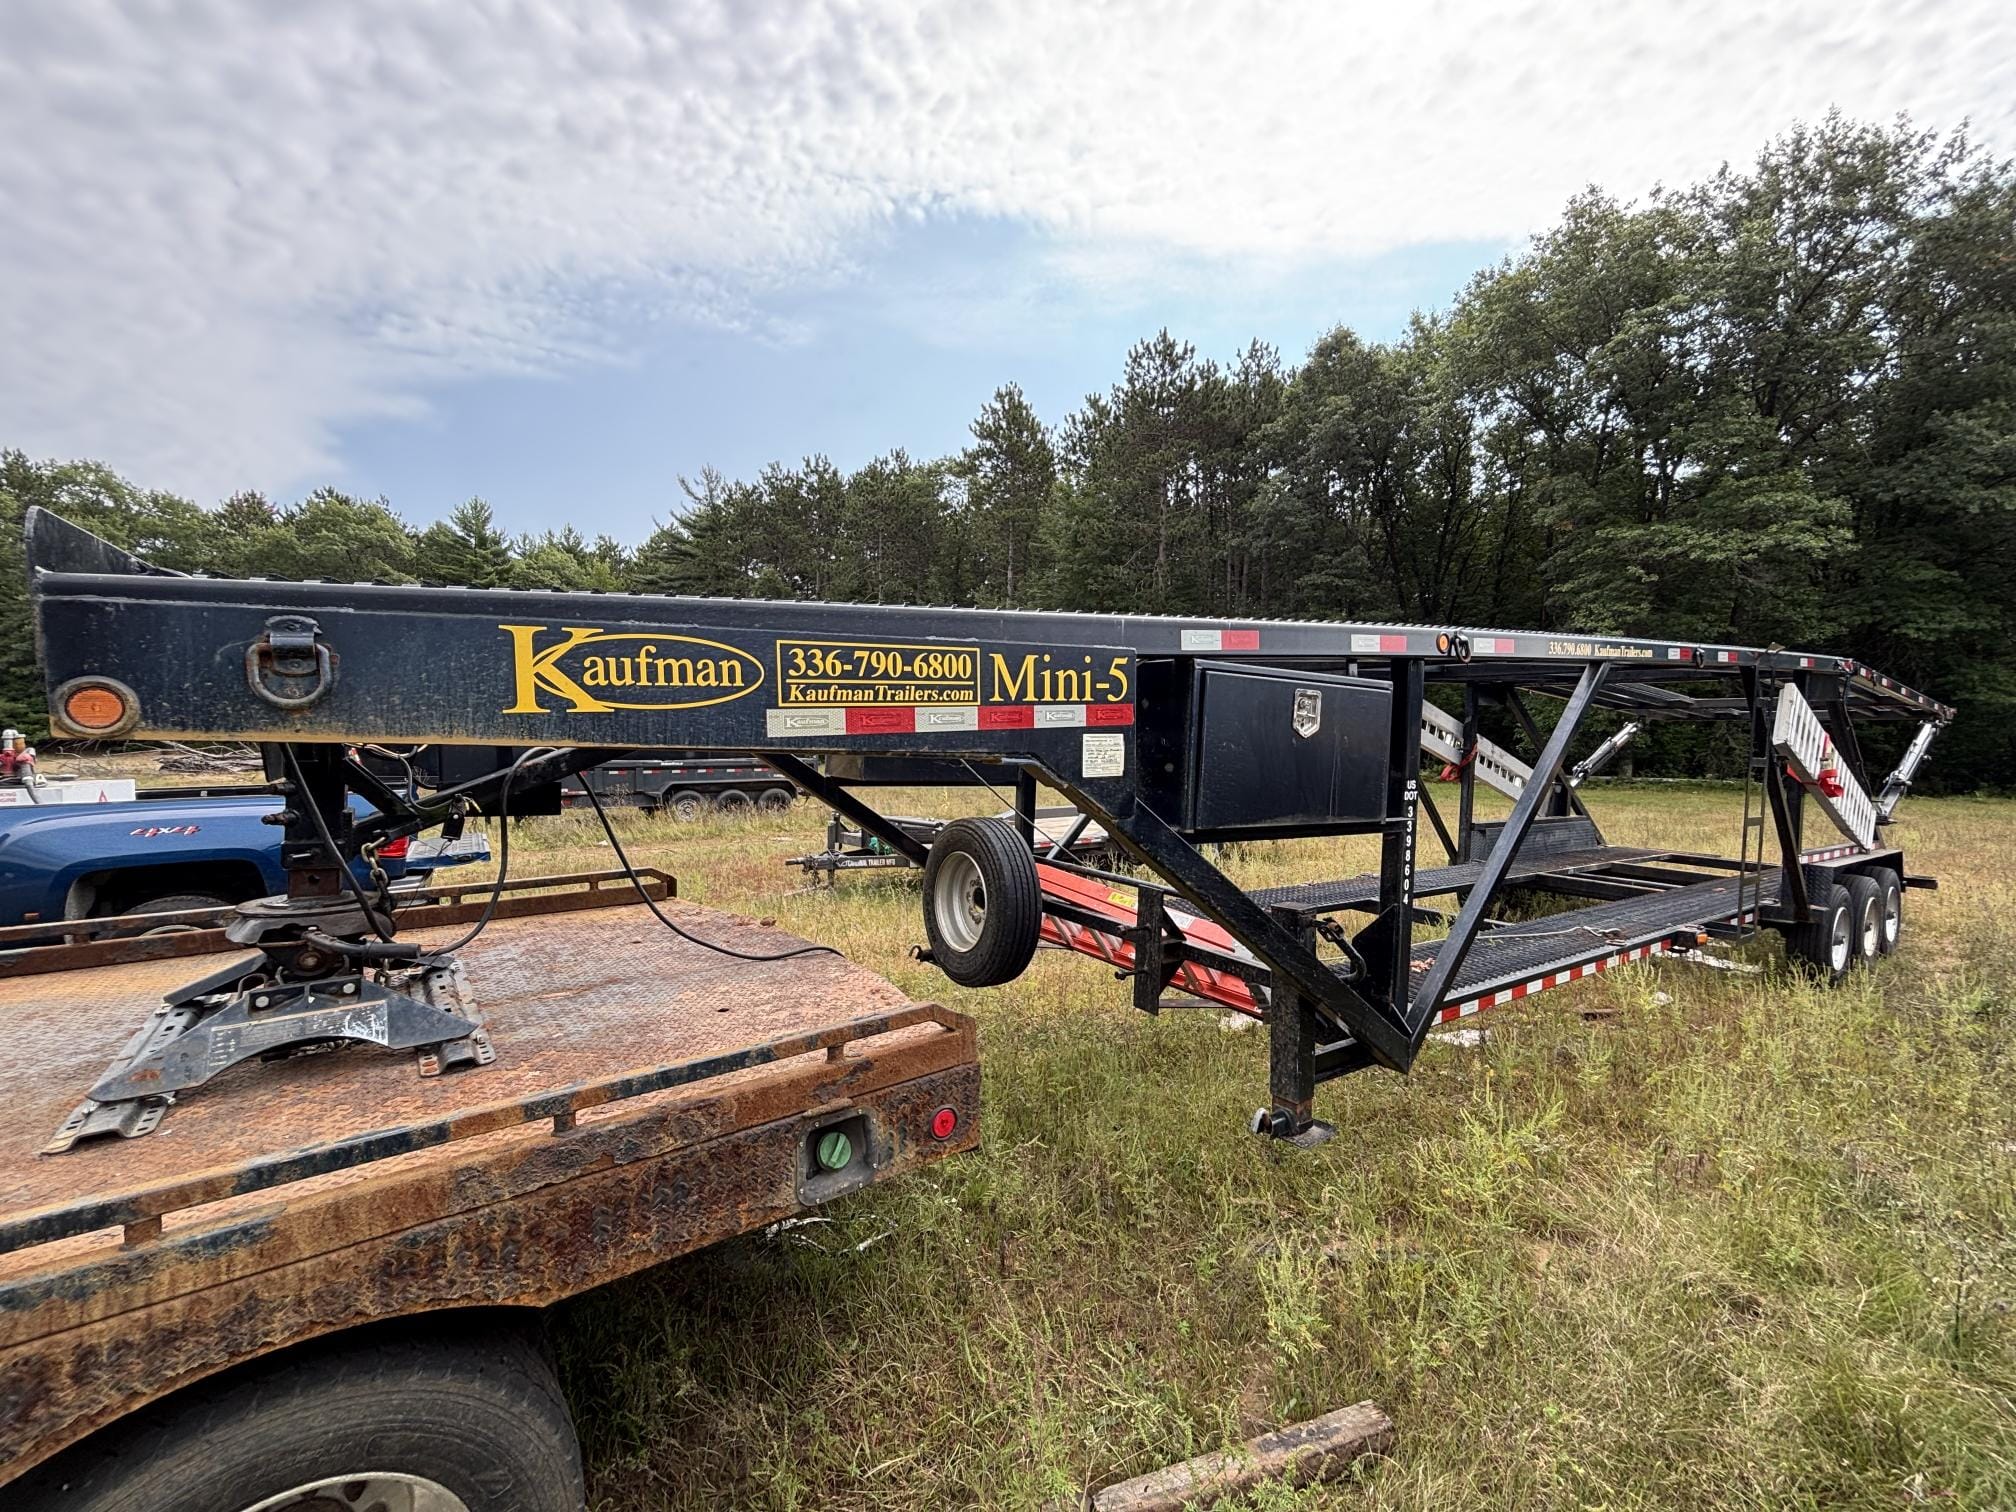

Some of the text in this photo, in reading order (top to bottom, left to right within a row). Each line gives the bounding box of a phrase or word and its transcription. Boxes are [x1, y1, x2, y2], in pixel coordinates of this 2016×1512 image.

[1548, 641, 1653, 658] 336.790.6800 KaufmanTrailers.com
[498, 624, 745, 714] Kaufman
[788, 647, 972, 679] 336-790-6800
[988, 653, 1129, 702] Mini-5
[788, 684, 974, 702] KaufmanTrailers.com
[1407, 780, 1416, 789] US
[1404, 791, 1418, 800] DOT
